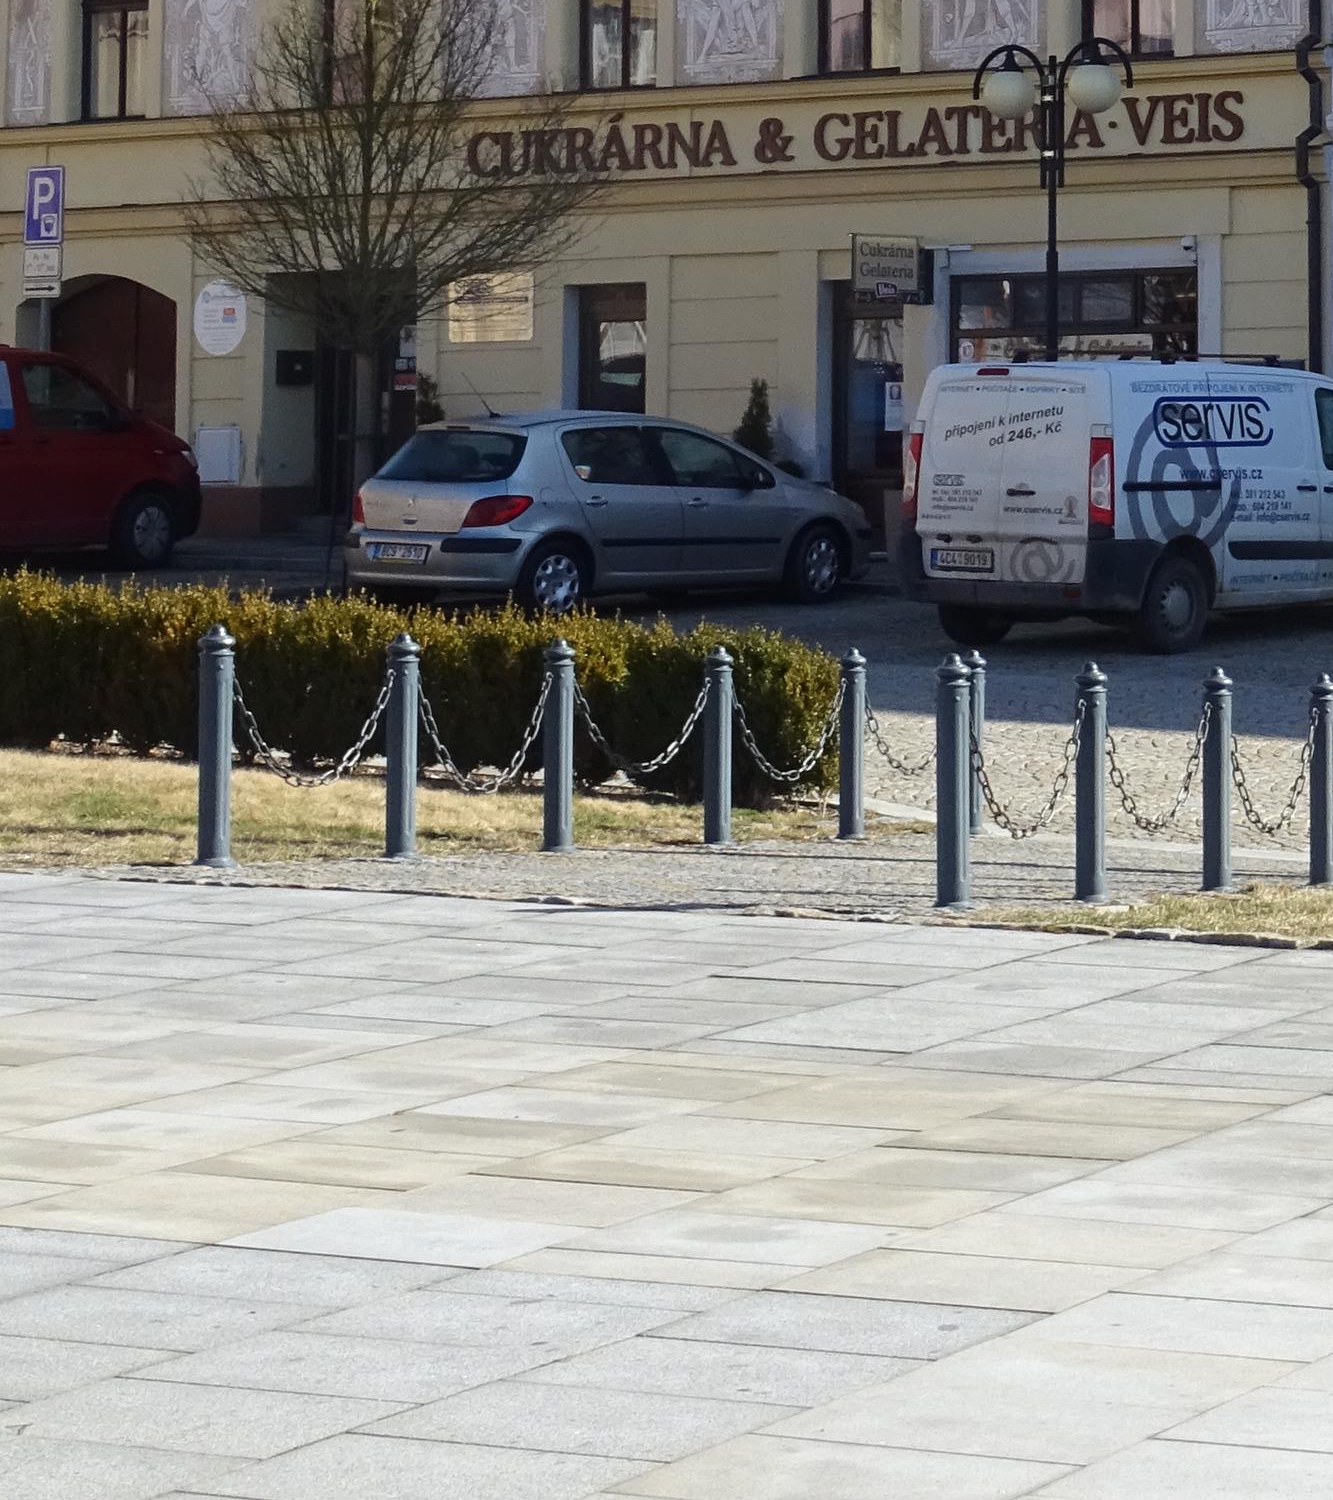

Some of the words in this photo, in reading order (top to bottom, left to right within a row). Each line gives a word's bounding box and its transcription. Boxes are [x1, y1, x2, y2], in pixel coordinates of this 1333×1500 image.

[466, 112, 737, 178] CUKRÁRNA
[754, 117, 795, 163] &
[813, 100, 1103, 162] GELATERA
[1122, 90, 1244, 147] VEIS
[33, 177, 55, 220] P
[860, 242, 914, 259] Cukrárna
[860, 262, 914, 279] Gelateria
[945, 419, 995, 441] připojení
[998, 415, 1005, 427] k
[1008, 405, 1064, 424] internetu
[989, 432, 1005, 447] od
[1045, 421, 1063, 436] Kč
